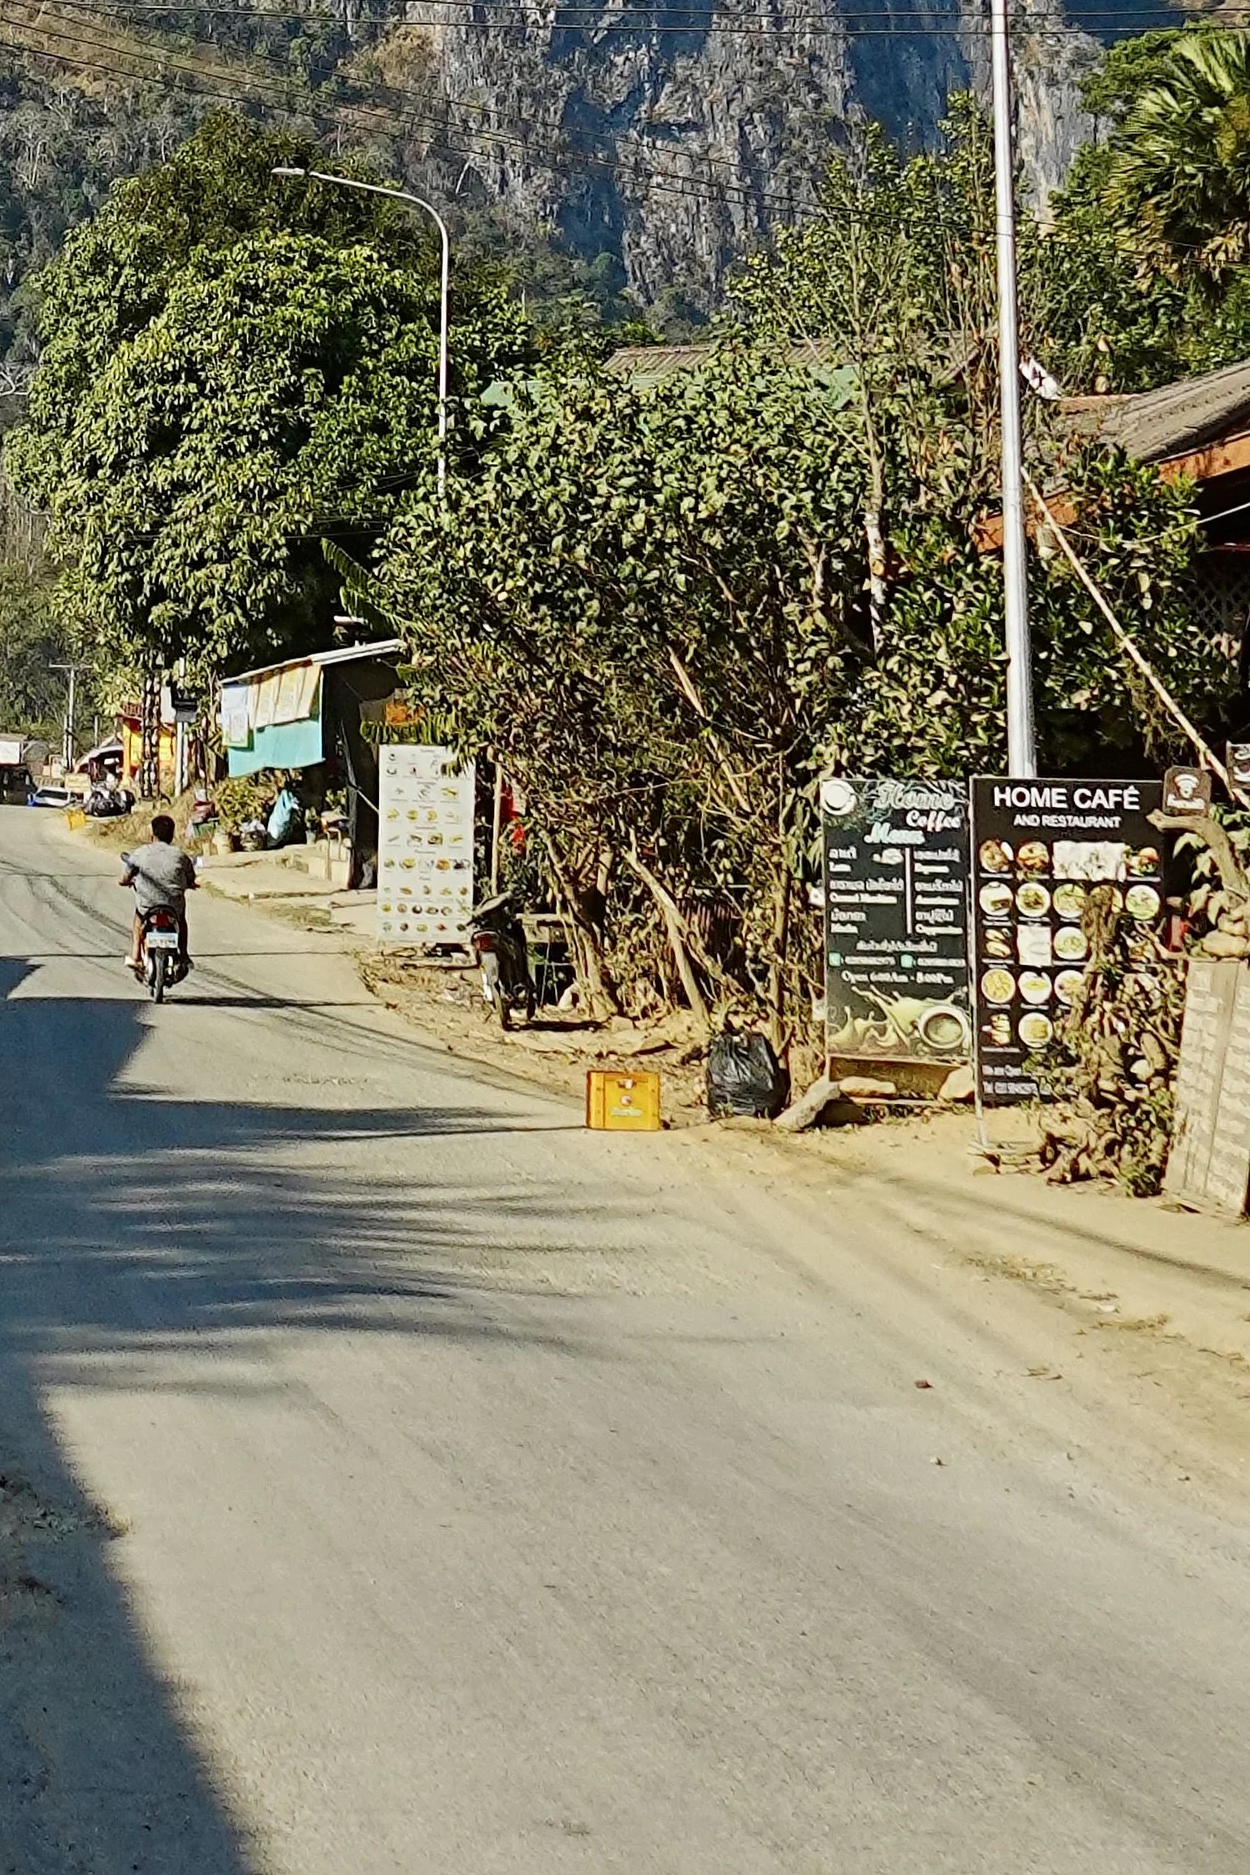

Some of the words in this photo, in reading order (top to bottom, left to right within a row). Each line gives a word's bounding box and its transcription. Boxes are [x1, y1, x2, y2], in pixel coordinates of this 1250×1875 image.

[872, 780, 955, 810] Home
[993, 786, 1067, 809] HOME
[1073, 785, 1140, 810] CAFÉ
[906, 810, 962, 832] Coffee
[1013, 814, 1041, 827] AND
[1041, 814, 1121, 828] RESTAURANT
